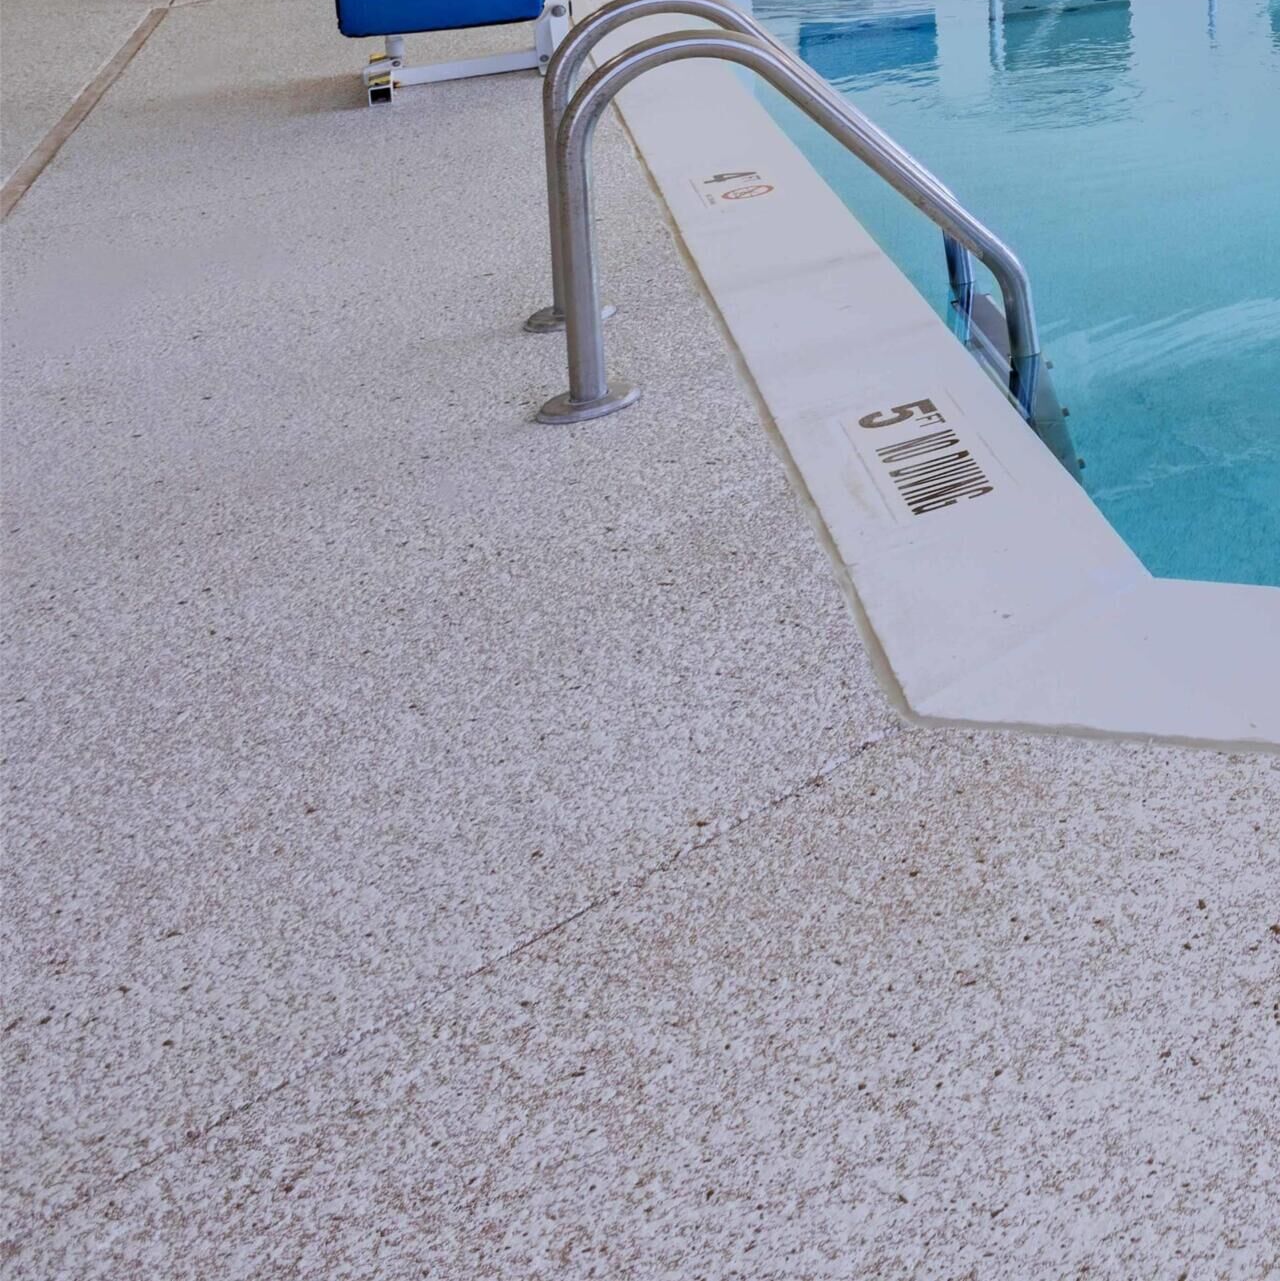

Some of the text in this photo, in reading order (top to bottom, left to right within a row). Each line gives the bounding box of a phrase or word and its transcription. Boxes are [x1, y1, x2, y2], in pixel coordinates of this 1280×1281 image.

[859, 398, 995, 516] 5 FT NO DIVING
